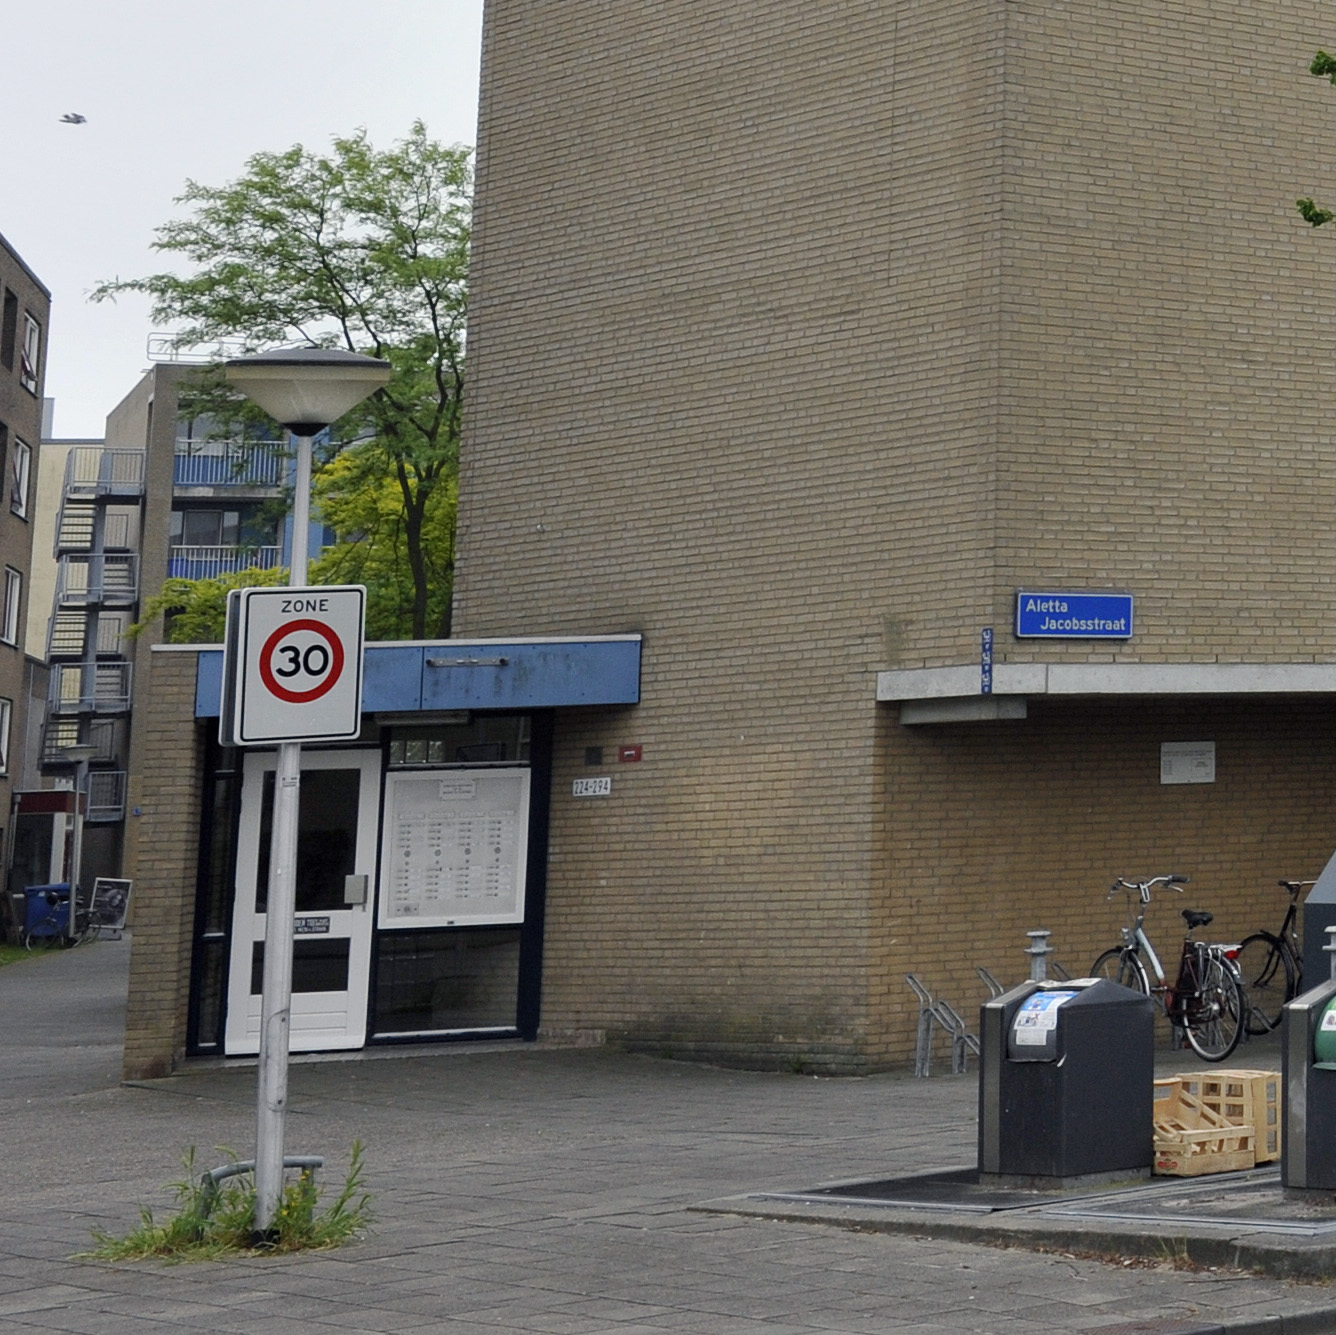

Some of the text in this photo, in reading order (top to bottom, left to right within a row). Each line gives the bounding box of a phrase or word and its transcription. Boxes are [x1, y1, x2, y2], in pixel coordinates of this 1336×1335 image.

[281, 599, 329, 613] ZONE
[1025, 599, 1068, 613] Aletta
[1040, 617, 1126, 631] Jacobsstraat
[275, 645, 329, 677] 30
[574, 780, 609, 795] 224-294
